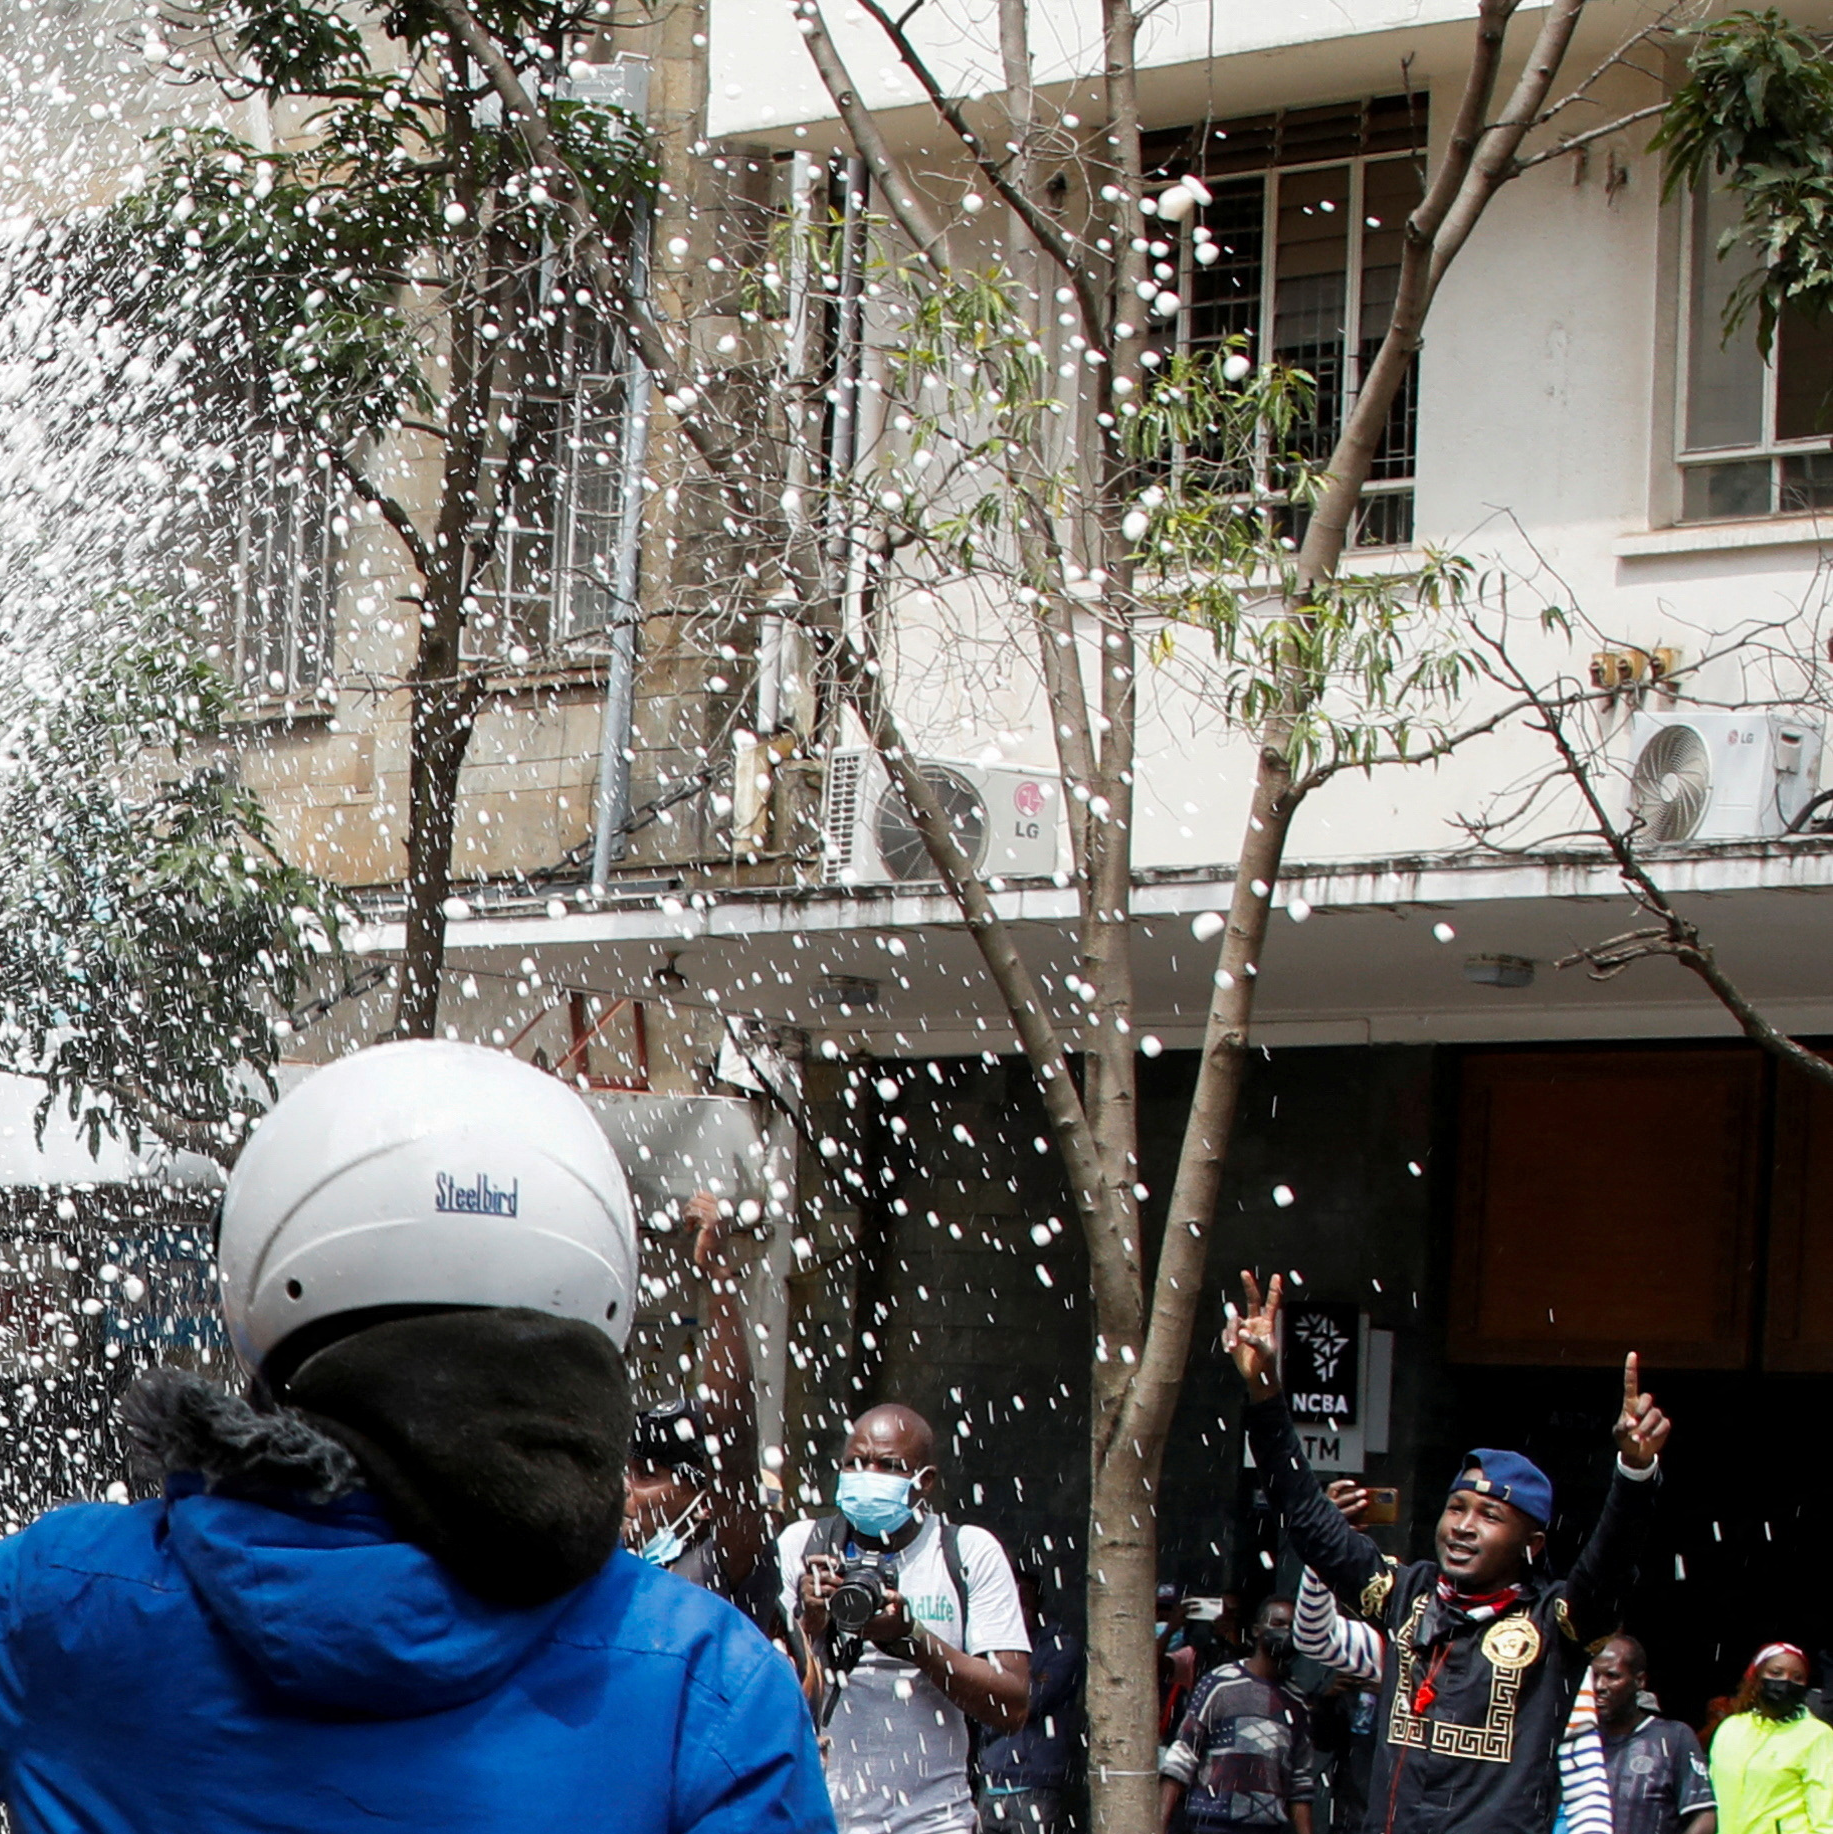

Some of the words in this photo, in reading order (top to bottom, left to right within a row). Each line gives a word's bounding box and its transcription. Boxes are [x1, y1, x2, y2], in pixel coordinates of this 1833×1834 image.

[1741, 732, 1754, 744] LG
[1015, 821, 1039, 839] LG
[435, 1172, 518, 1216] Steelbird
[1292, 1393, 1349, 1414] NCBA
[1303, 1436, 1340, 1461] TM
